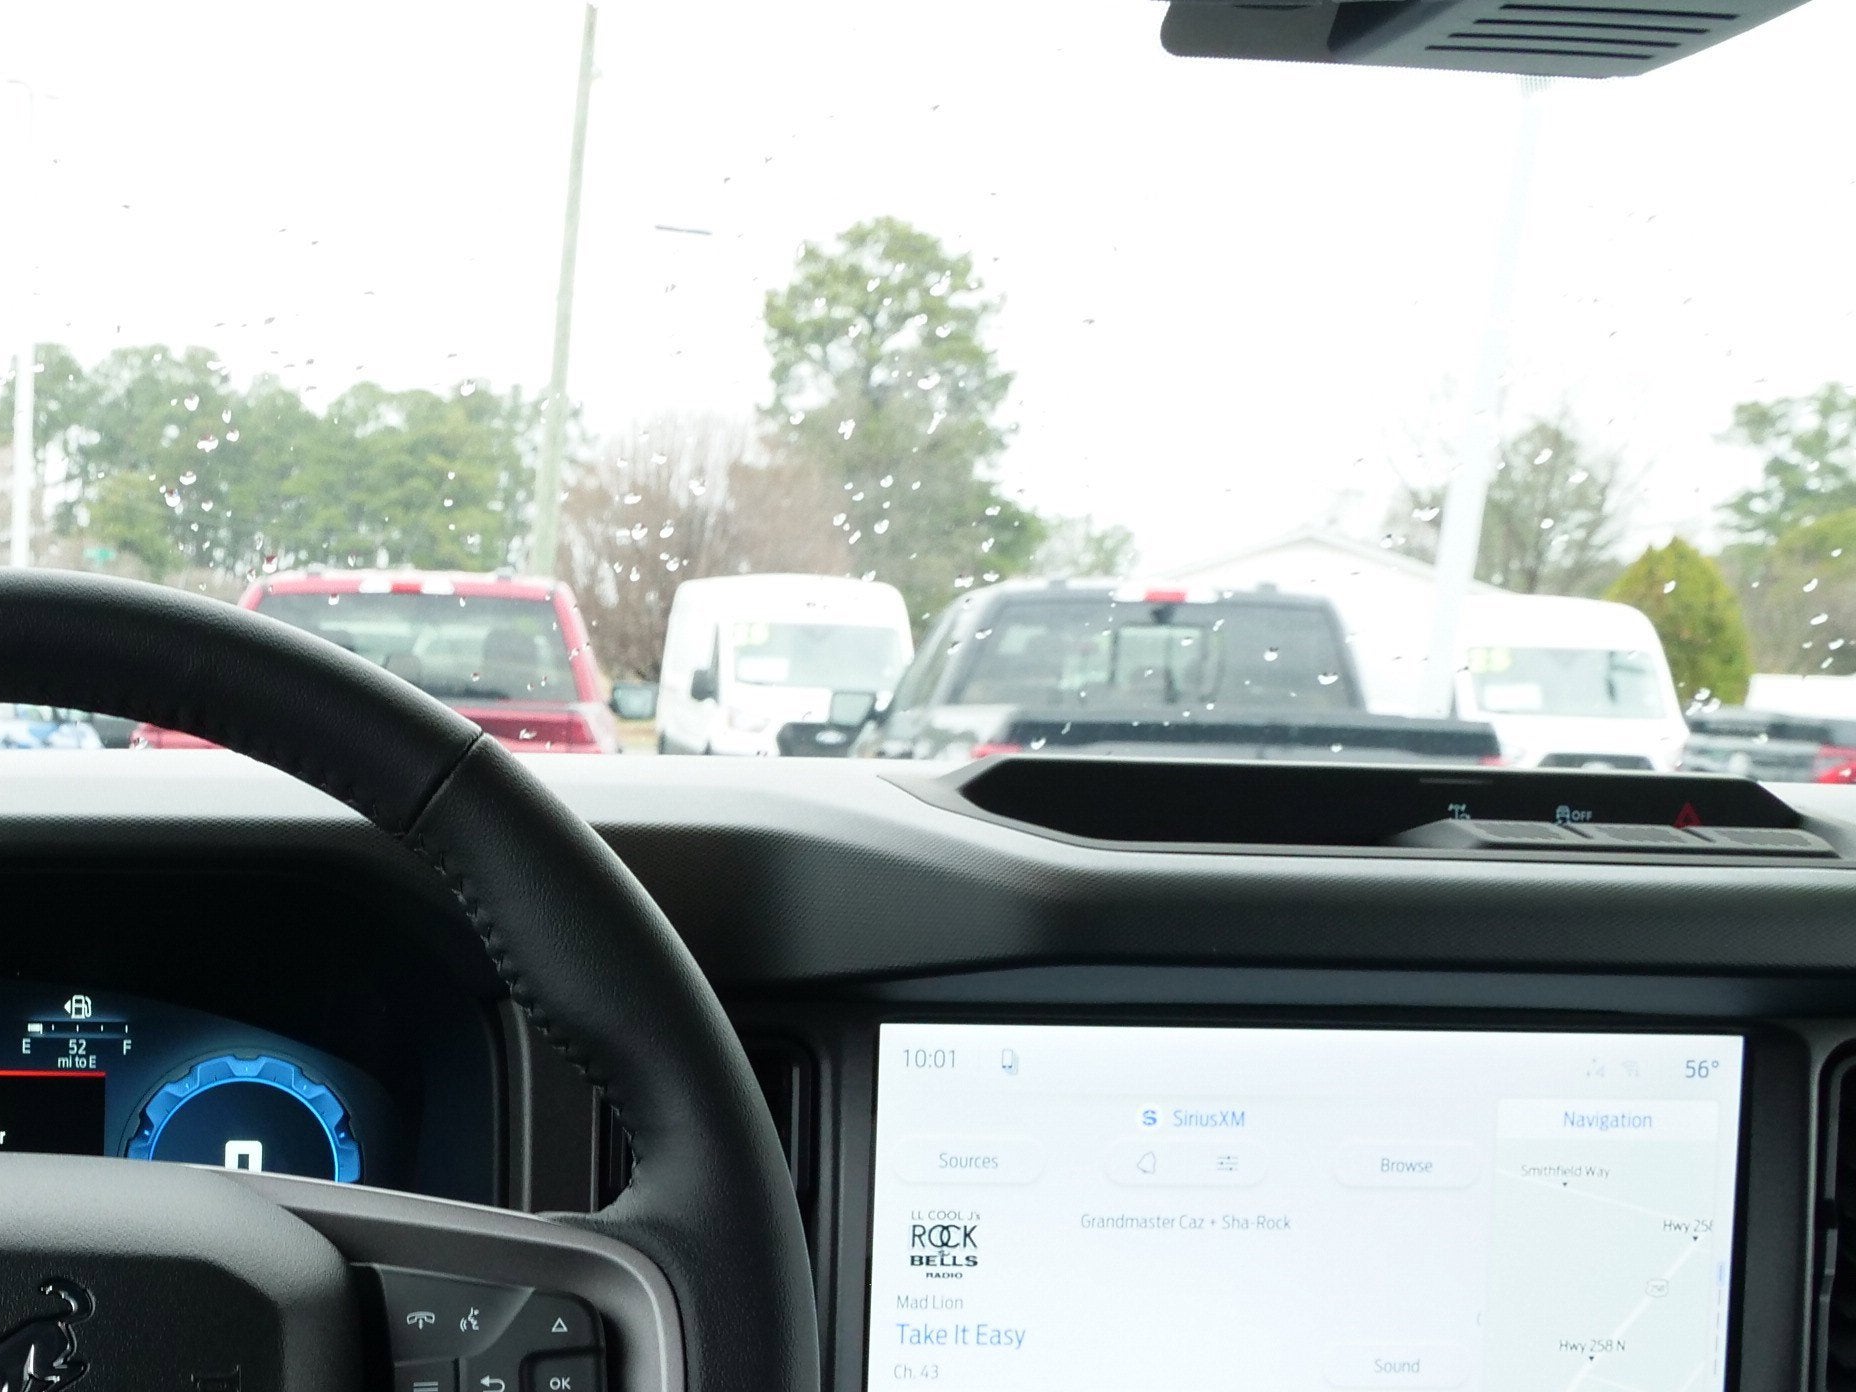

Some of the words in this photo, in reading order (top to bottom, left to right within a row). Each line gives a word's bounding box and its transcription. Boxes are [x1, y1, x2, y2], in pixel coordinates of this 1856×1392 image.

[1571, 809, 1593, 822] OFF
[22, 1039, 32, 1055] E
[68, 1039, 87, 1056] 52
[122, 1039, 132, 1056] F
[57, 1055, 74, 1069] mi
[75, 1055, 88, 1069] to
[89, 1055, 97, 1069] E
[901, 1048, 958, 1070] 10:01
[1684, 1060, 1720, 1080] 56°
[1172, 1109, 1246, 1129] SiriusXM
[1563, 1111, 1653, 1132] Navigation
[938, 1152, 1000, 1171] Sources
[1380, 1157, 1434, 1174] Browse
[1520, 1164, 1582, 1179] Smithfield
[1585, 1165, 1611, 1181] Way
[927, 1210, 963, 1221] COOL
[1080, 1213, 1176, 1230] Grandmaster
[1178, 1214, 1205, 1231] Caz
[1221, 1214, 1292, 1231] Sha-Rock
[1662, 1219, 1691, 1234] Hwy
[910, 1224, 979, 1250] ROCK
[909, 1254, 979, 1268] BELLS
[925, 1271, 964, 1280] RADIO
[896, 1295, 929, 1311] Mad
[931, 1295, 964, 1311] Lion
[895, 1322, 948, 1346] Take
[955, 1323, 970, 1346] It
[975, 1324, 1027, 1351] Easy
[1558, 1339, 1587, 1355] Hwy
[1590, 1338, 1614, 1353] 258
[1616, 1338, 1627, 1353] N
[893, 1363, 917, 1380] Ch.
[920, 1363, 940, 1380] 43
[1373, 1358, 1421, 1375] Sound
[549, 1376, 572, 1391] OK
